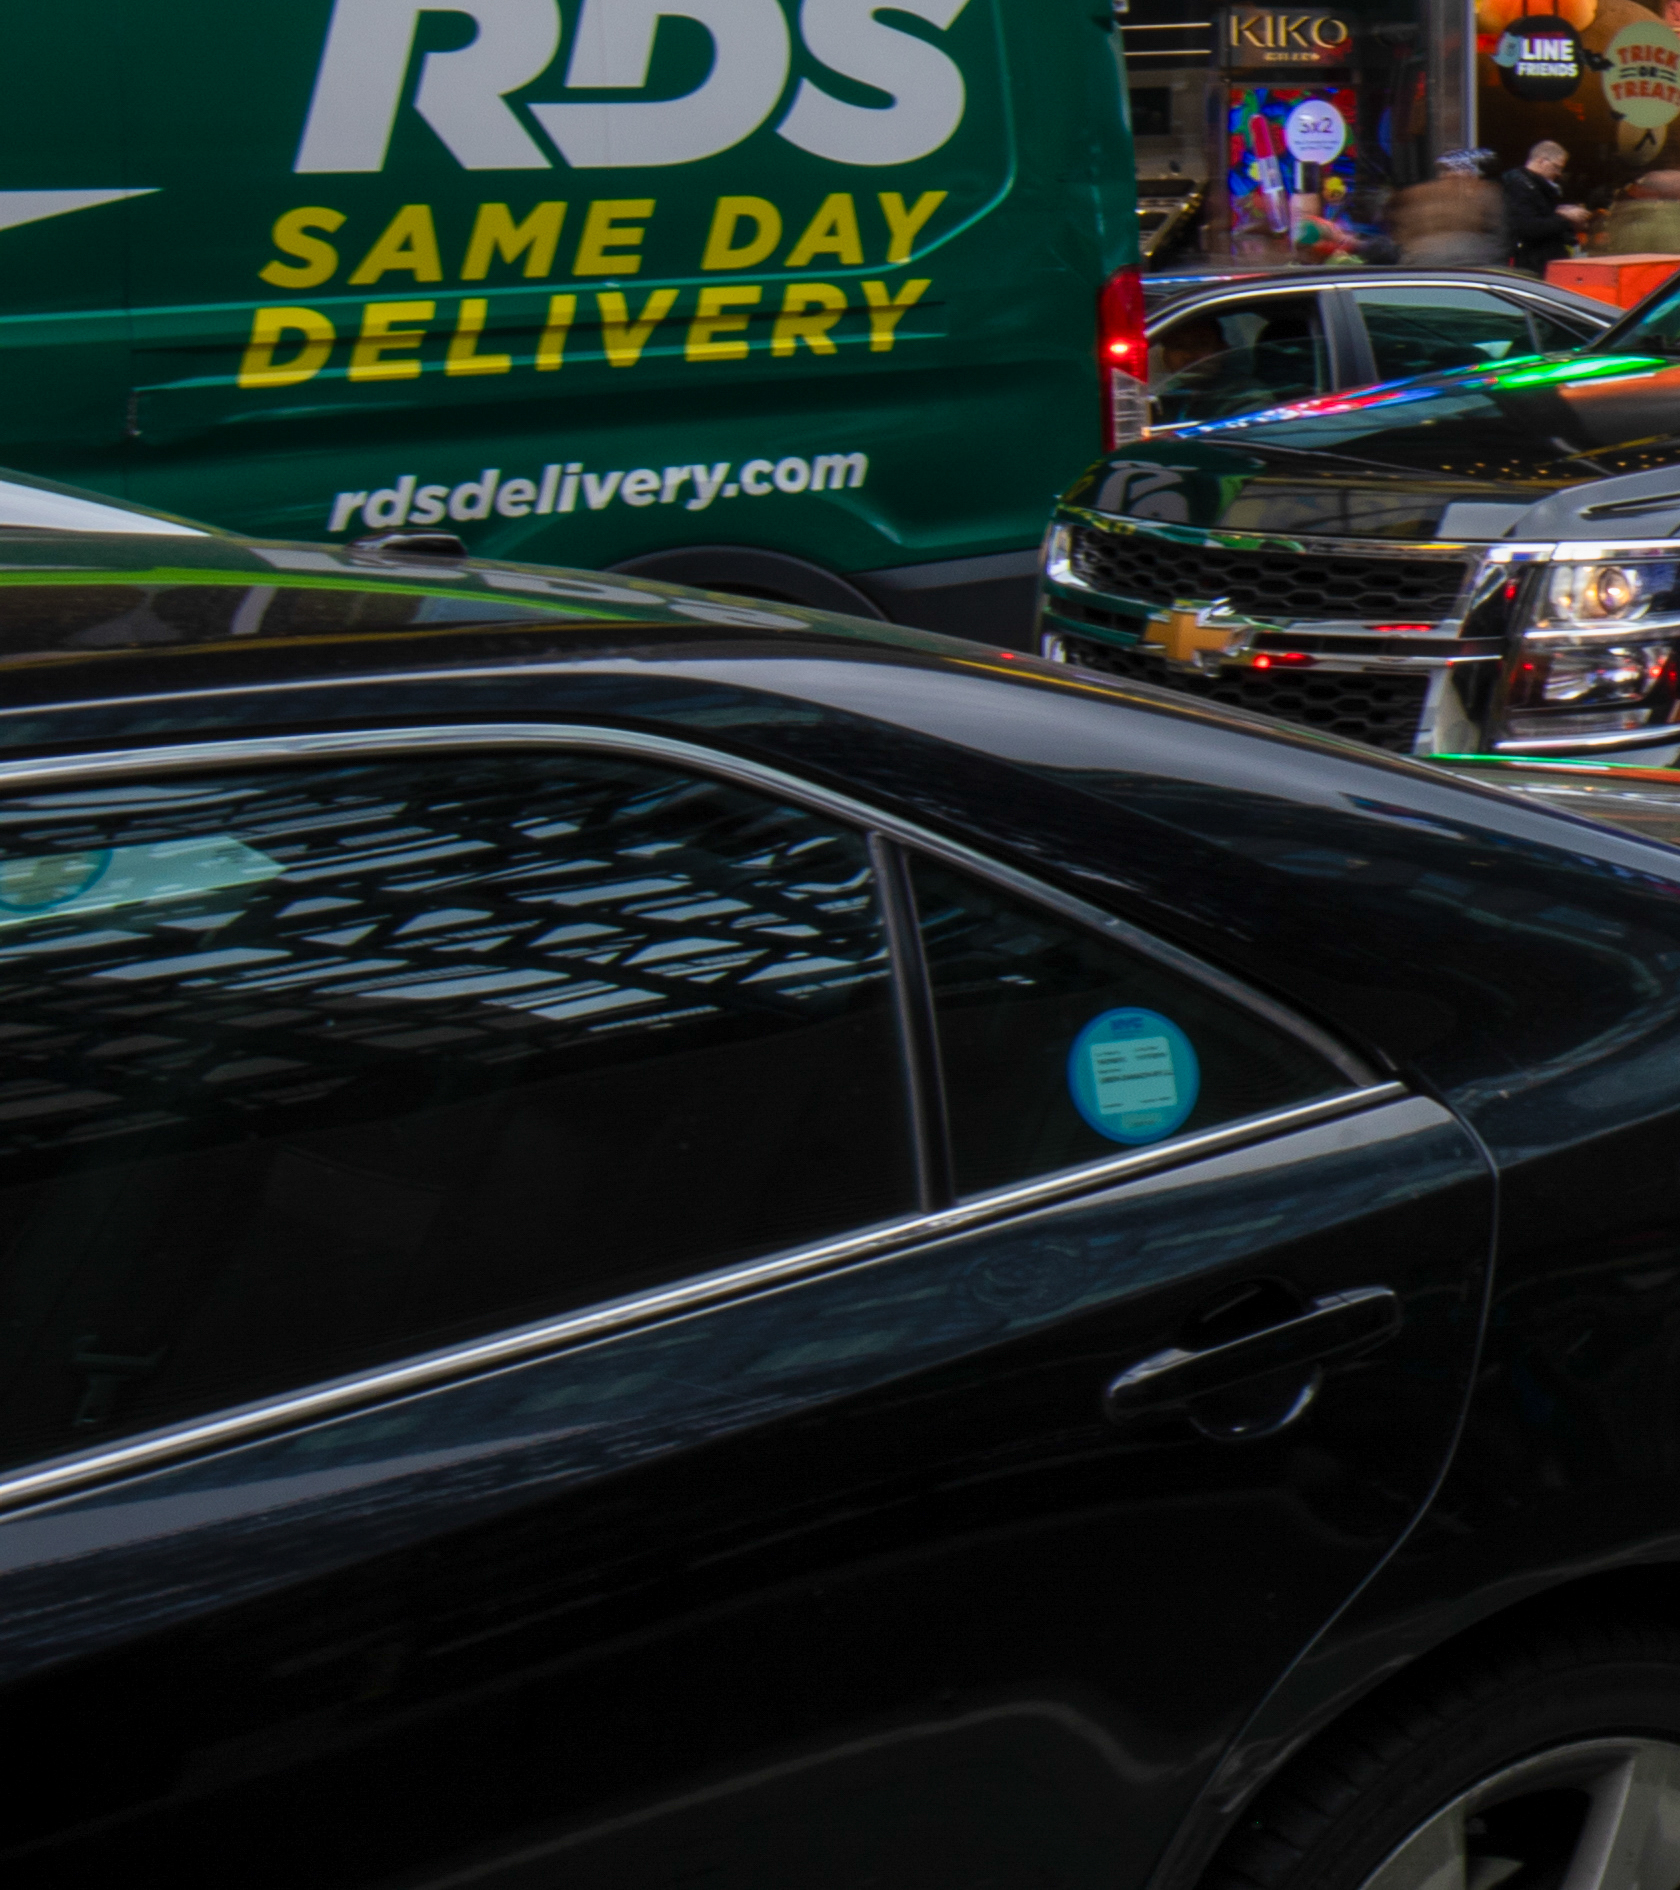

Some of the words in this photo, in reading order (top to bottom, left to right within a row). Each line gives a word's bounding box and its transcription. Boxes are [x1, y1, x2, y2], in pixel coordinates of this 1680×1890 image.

[1228, 14, 1349, 49] KIKO
[1520, 38, 1575, 62] LINE
[1616, 44, 1680, 67] TRICK
[1515, 61, 1579, 79] FRIENDS
[1636, 64, 1659, 79] OR
[258, 198, 656, 289] SAME
[700, 190, 948, 270] DAY
[236, 279, 933, 389] DELIVERY
[327, 451, 869, 532] rdsdelivery.com
